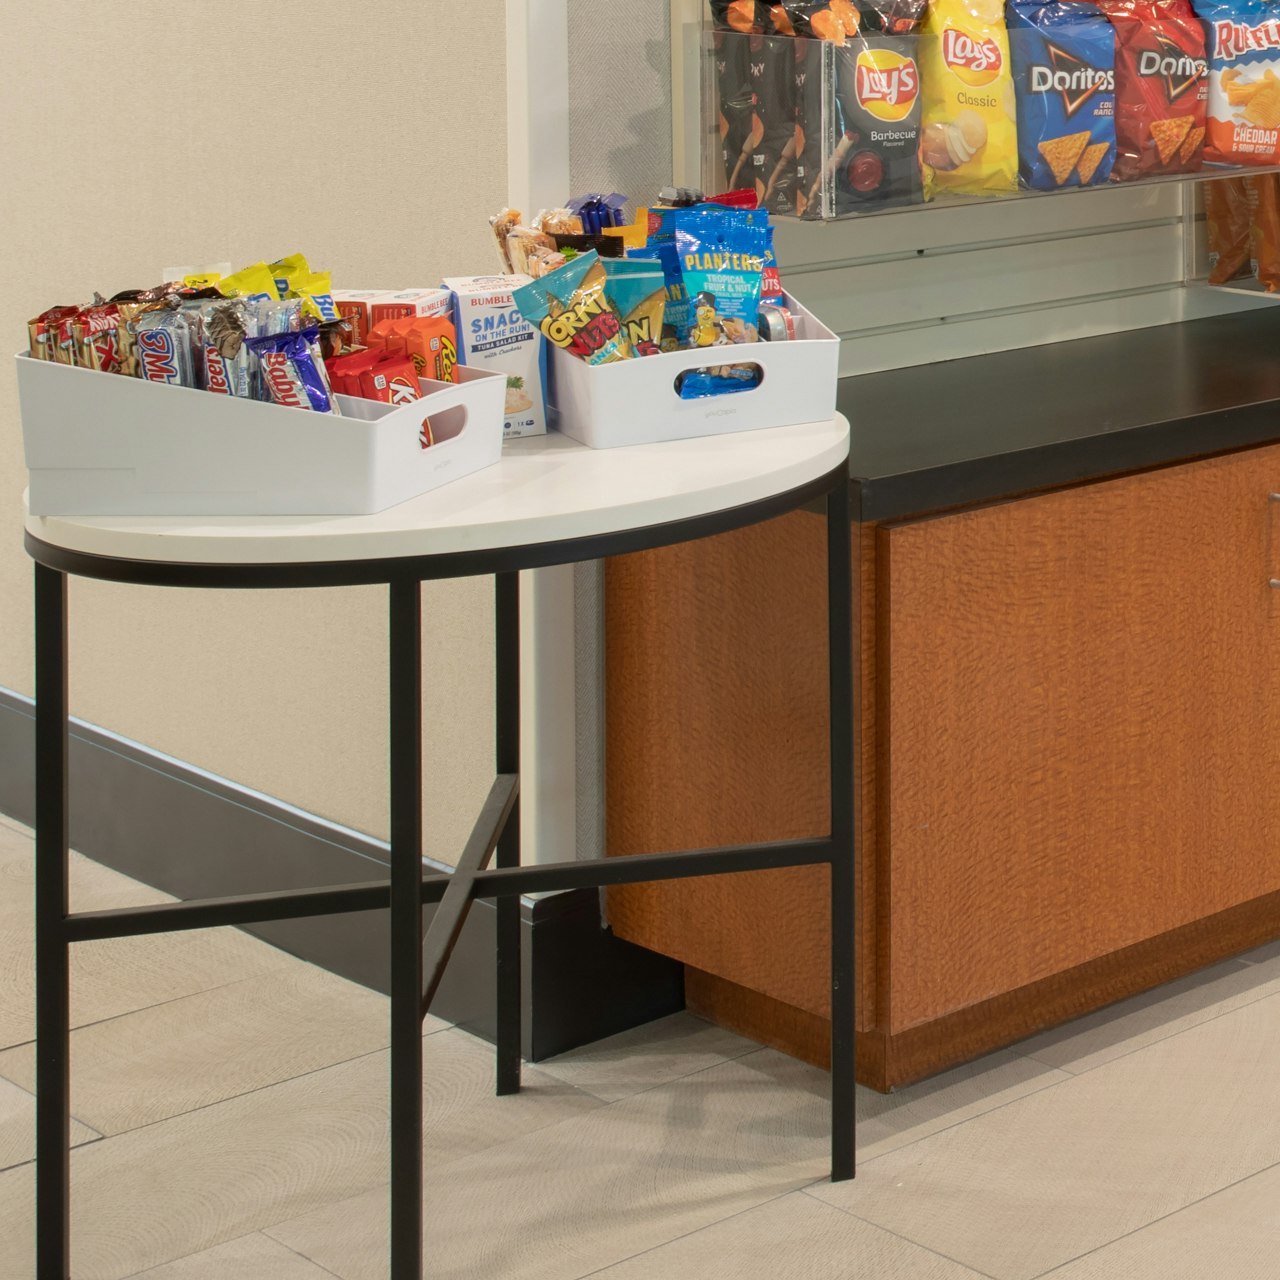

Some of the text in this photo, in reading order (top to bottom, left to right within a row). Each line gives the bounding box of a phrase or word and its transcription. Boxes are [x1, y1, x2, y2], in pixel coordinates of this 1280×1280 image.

[946, 30, 996, 71] Lay's
[1140, 52, 1208, 76] Doritos
[859, 64, 916, 105] Lay's
[1032, 66, 1114, 91] Doritos
[957, 91, 997, 108] Classic
[870, 130, 916, 141] Barbecue
[1233, 127, 1277, 145] CHEDDAR
[685, 252, 761, 272] PLANTERS
[703, 282, 725, 292] FRUIT
[735, 283, 752, 292] NUT
[705, 273, 744, 284] TROPICAL
[421, 301, 439, 314] BUMBLE
[471, 295, 512, 306] BUMBLE
[471, 309, 524, 334] SNAC
[541, 295, 601, 349] CORN
[475, 323, 530, 342] ON THE RUN!
[477, 333, 529, 351] TUNA SALAD KIT
[565, 311, 620, 357] NUTS
[590, 341, 618, 366] ANCH
